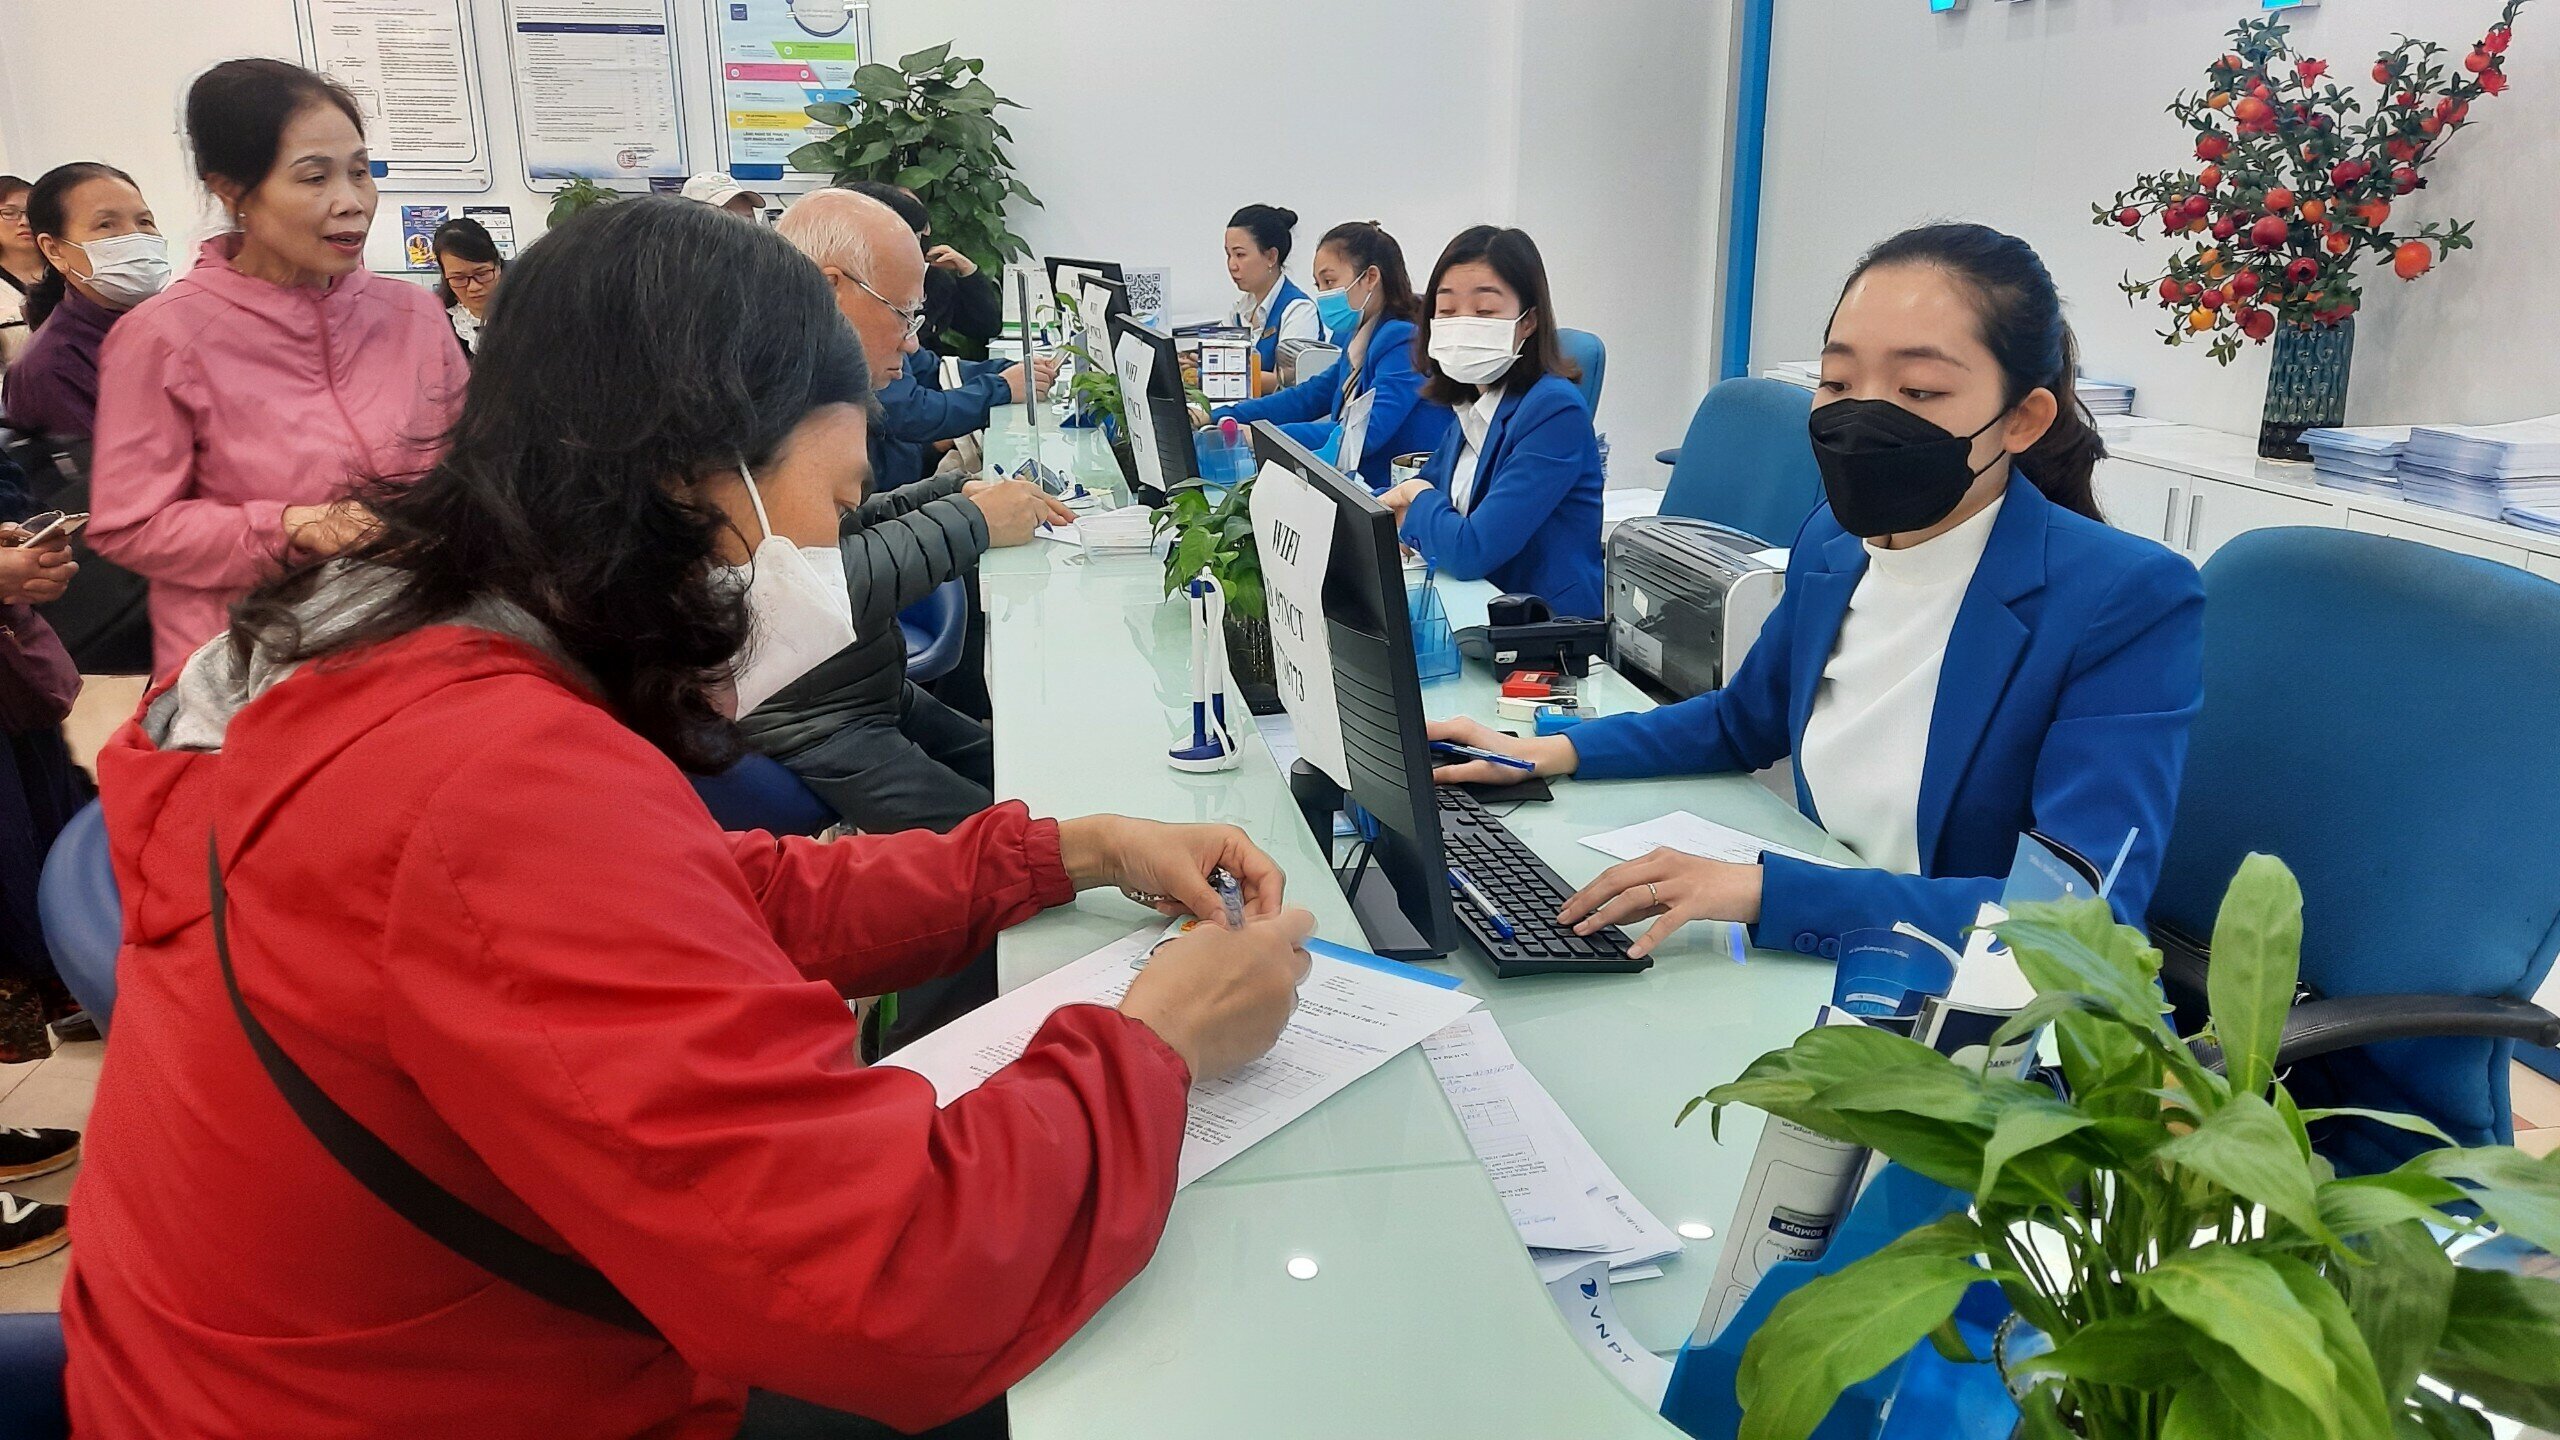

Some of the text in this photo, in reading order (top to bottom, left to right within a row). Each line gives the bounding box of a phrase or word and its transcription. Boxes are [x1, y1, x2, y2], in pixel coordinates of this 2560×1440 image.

[1272, 519, 1301, 567] WIFI
[1780, 1223, 1824, 1237] 80Mbps
[1590, 1305, 1635, 1363] VNPT
